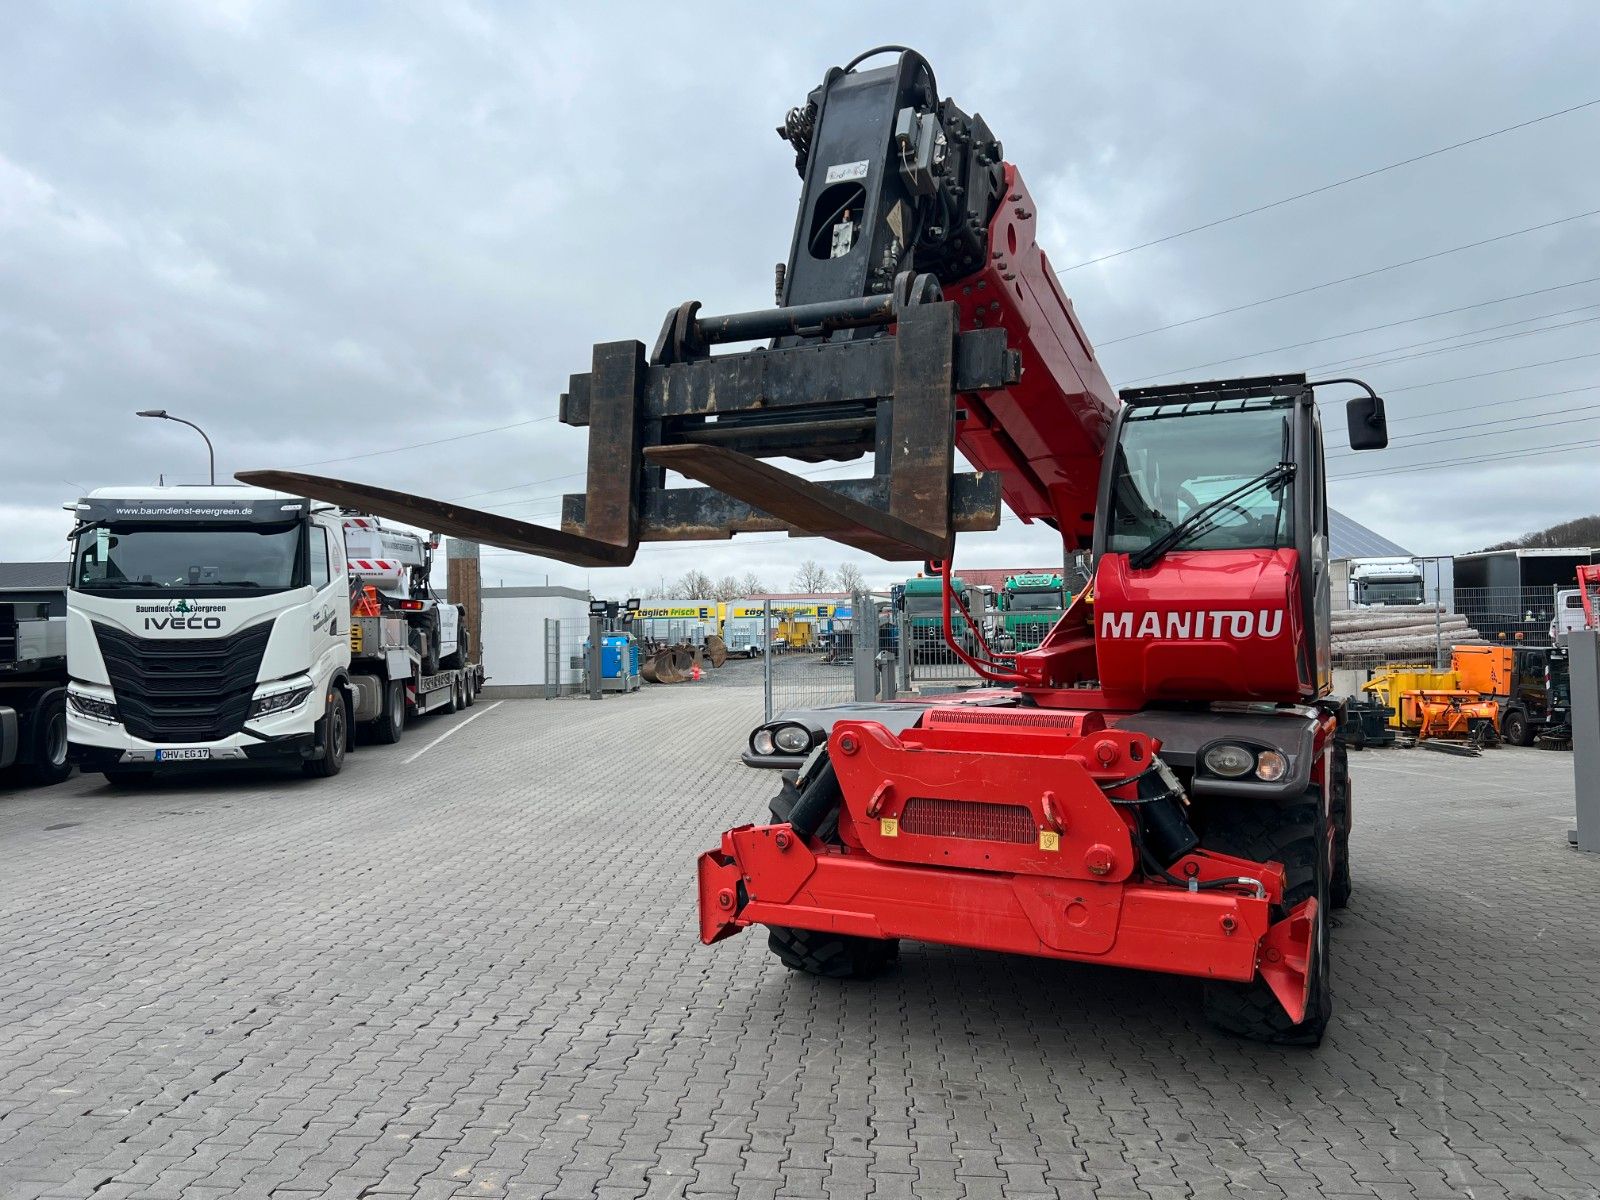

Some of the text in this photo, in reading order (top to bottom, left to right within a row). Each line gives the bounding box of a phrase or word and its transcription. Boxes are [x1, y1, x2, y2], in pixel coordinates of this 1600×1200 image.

[116, 507, 253, 517] www.baumdienst-evergreen.de
[136, 605, 226, 613] Baumdienst Evergreen
[637, 608, 695, 618] täglich frisch
[145, 618, 221, 630] IVECO
[1101, 610, 1283, 639] MANITOU
[161, 749, 208, 759] OHV EG 17
